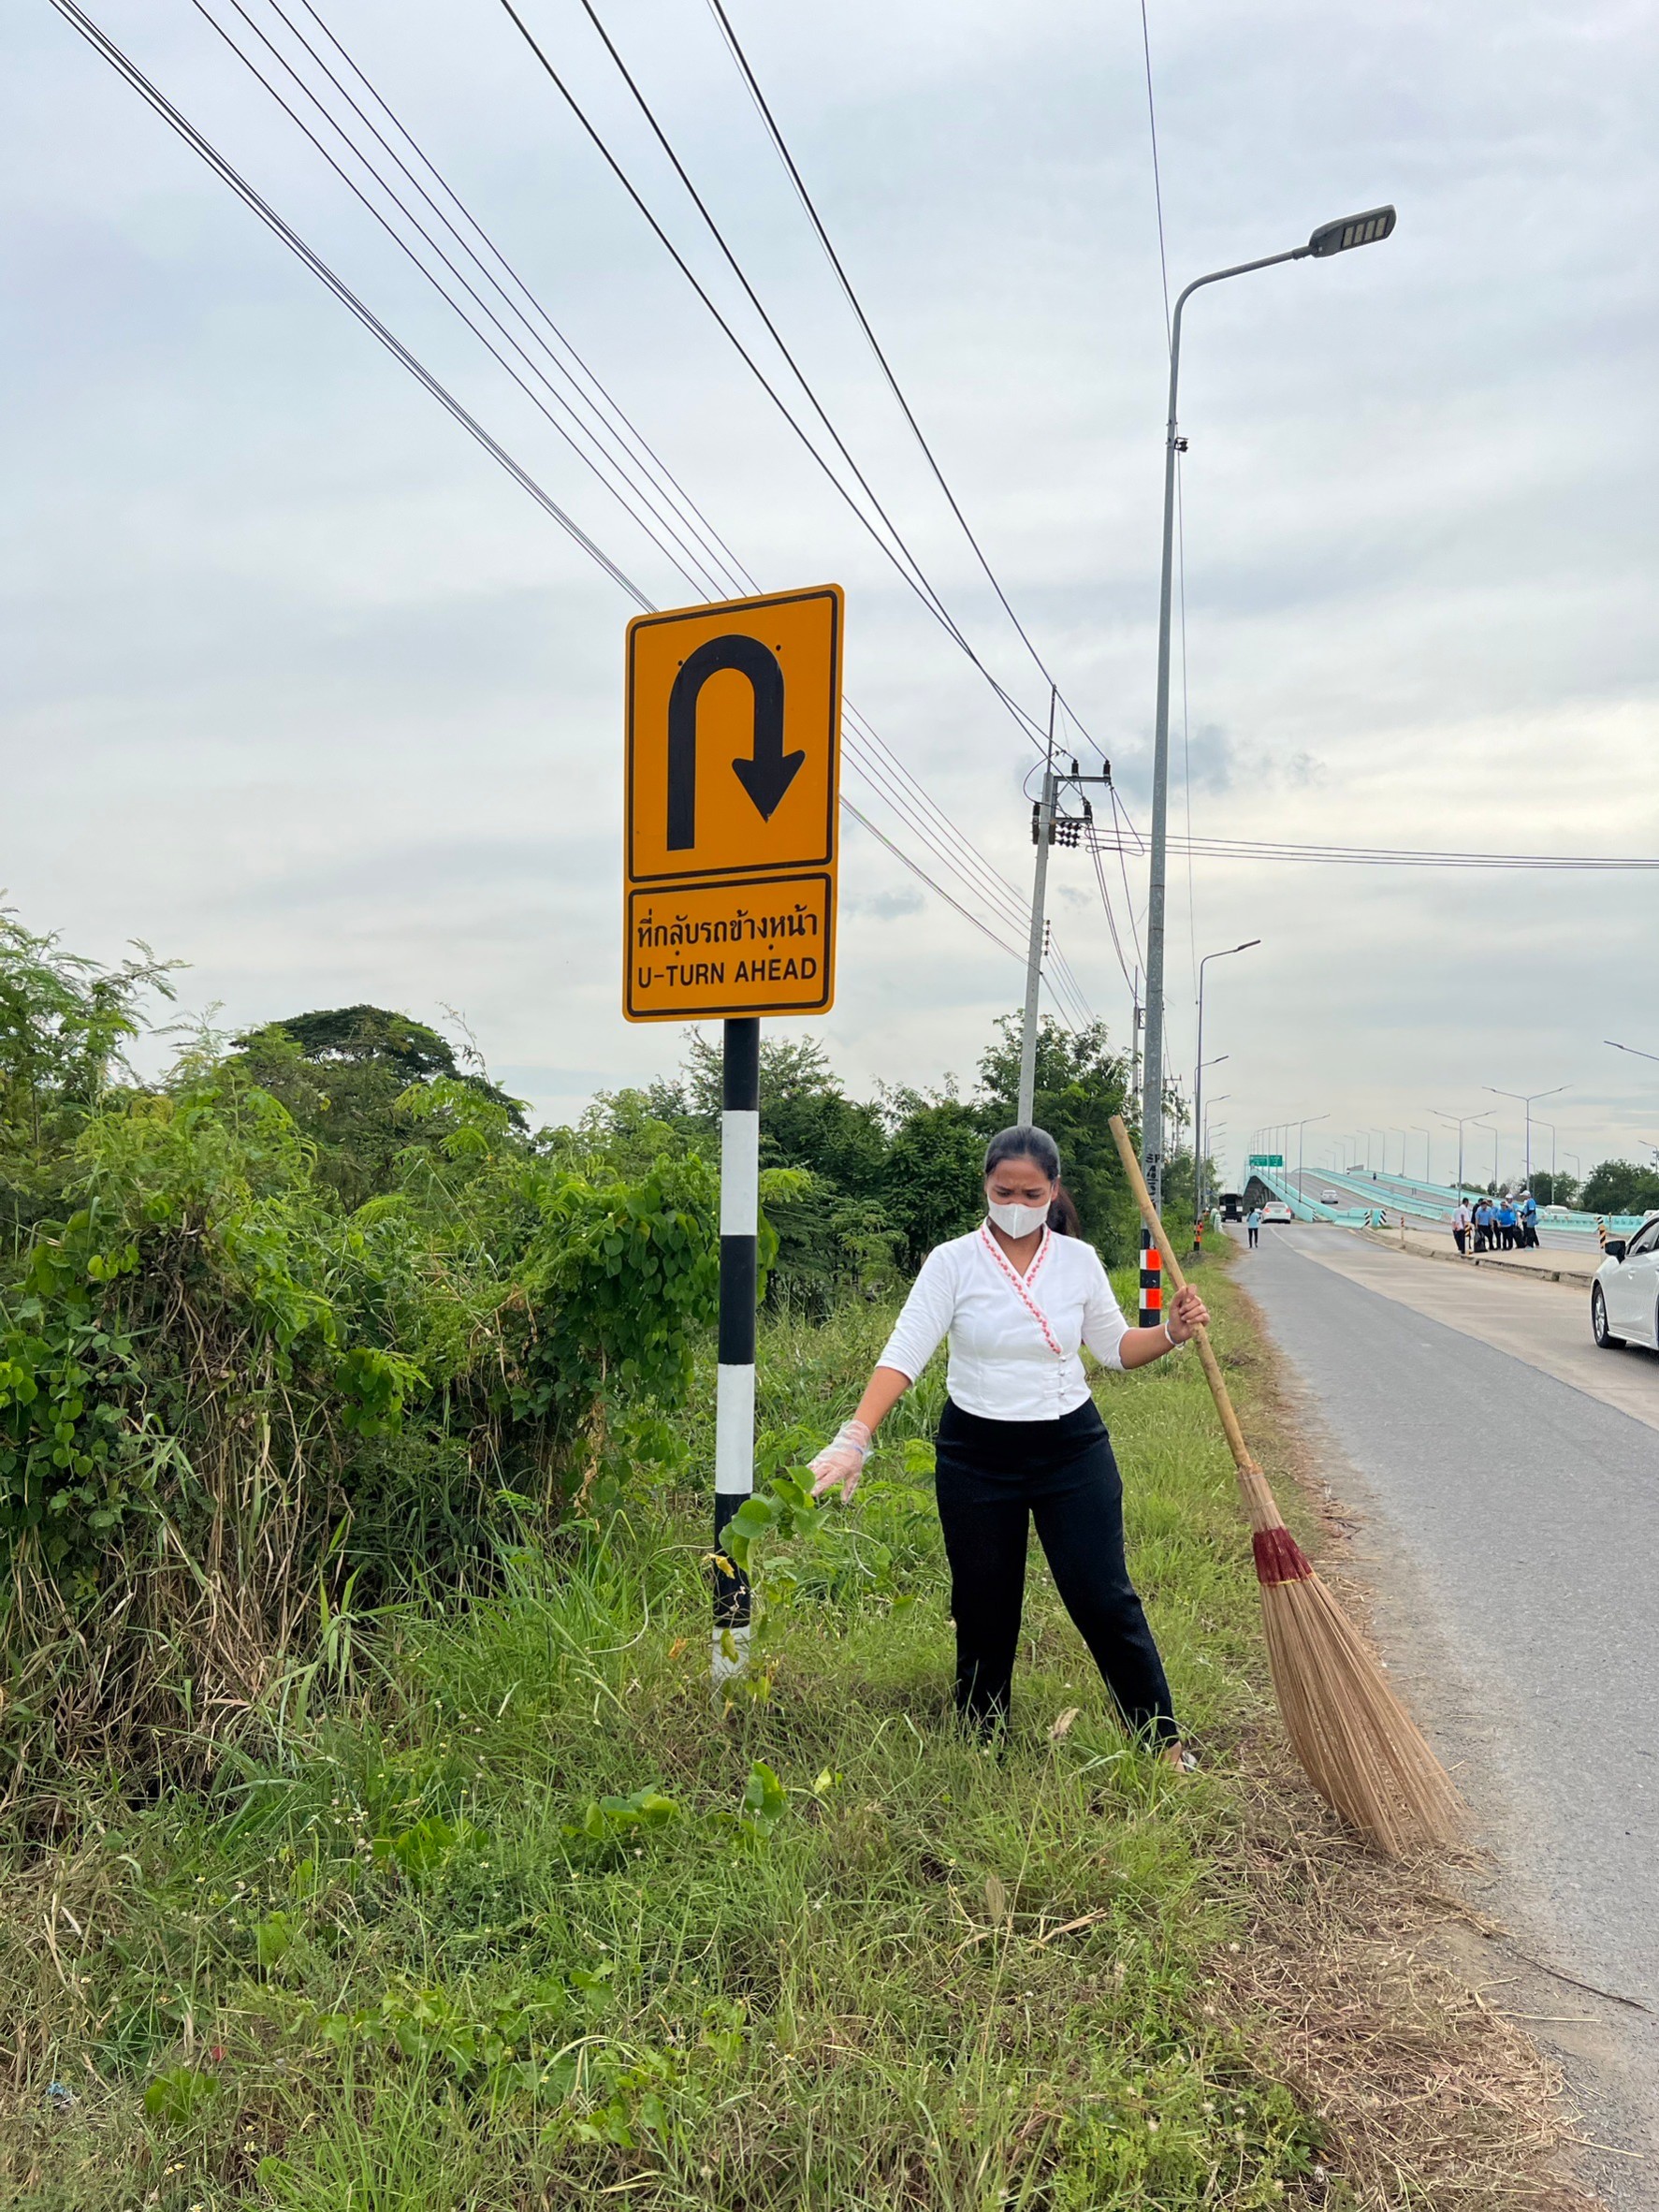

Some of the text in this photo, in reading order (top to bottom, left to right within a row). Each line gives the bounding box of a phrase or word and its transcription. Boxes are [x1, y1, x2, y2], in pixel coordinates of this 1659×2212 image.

[637, 904, 818, 948] ที่กลับรถข้างหน้า
[638, 957, 818, 988] U-TURN AHEAD
